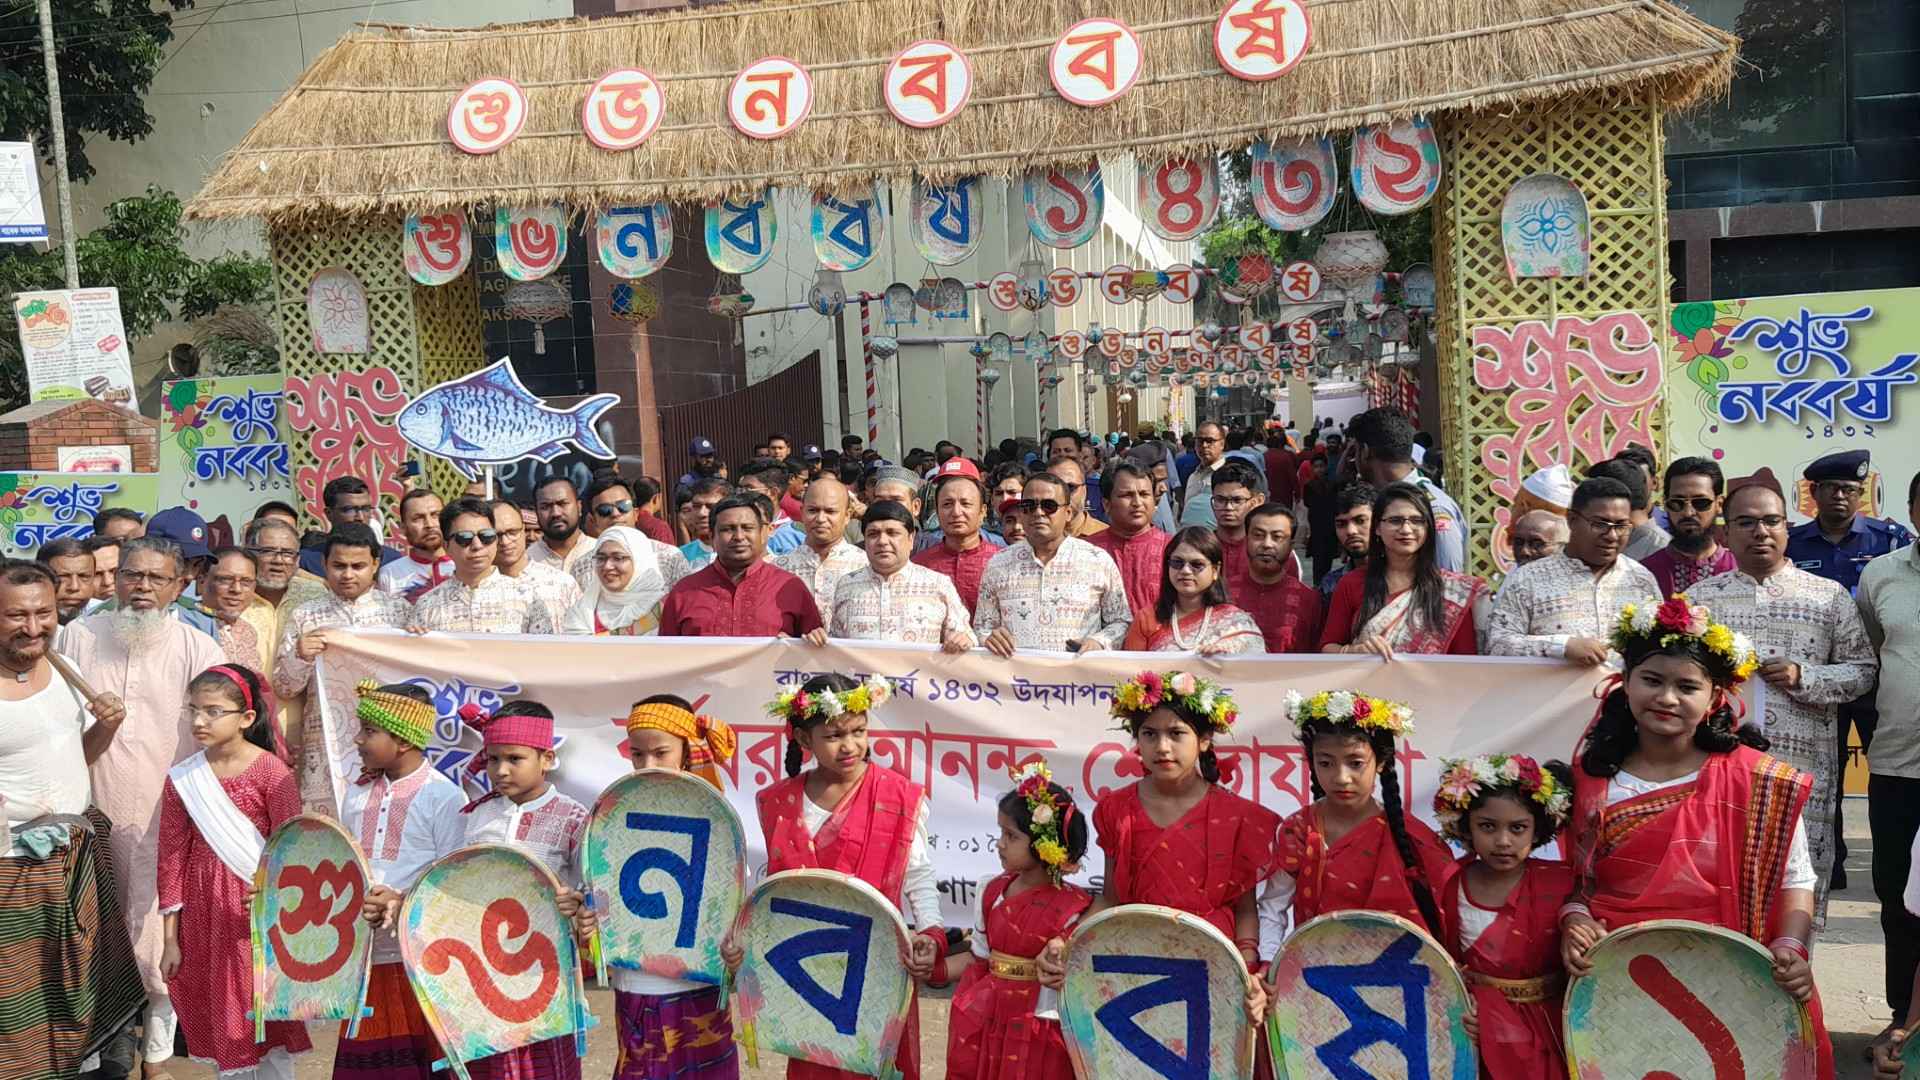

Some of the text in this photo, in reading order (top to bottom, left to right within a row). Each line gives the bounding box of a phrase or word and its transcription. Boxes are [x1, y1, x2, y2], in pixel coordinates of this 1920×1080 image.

[597, 82, 649, 138] ভ
[744, 71, 795, 126] ন
[900, 53, 952, 114] ব
[1067, 30, 1122, 91] ব
[608, 205, 658, 259] ন
[1729, 307, 1873, 376] শুভ
[203, 387, 284, 442] শুভ
[1718, 354, 1920, 423] নববর্ষ
[1805, 424, 1877, 439] ১৪৩২
[928, 678, 1002, 705] ১৪৩২
[619, 812, 711, 949] ন
[764, 897, 873, 1036] ব
